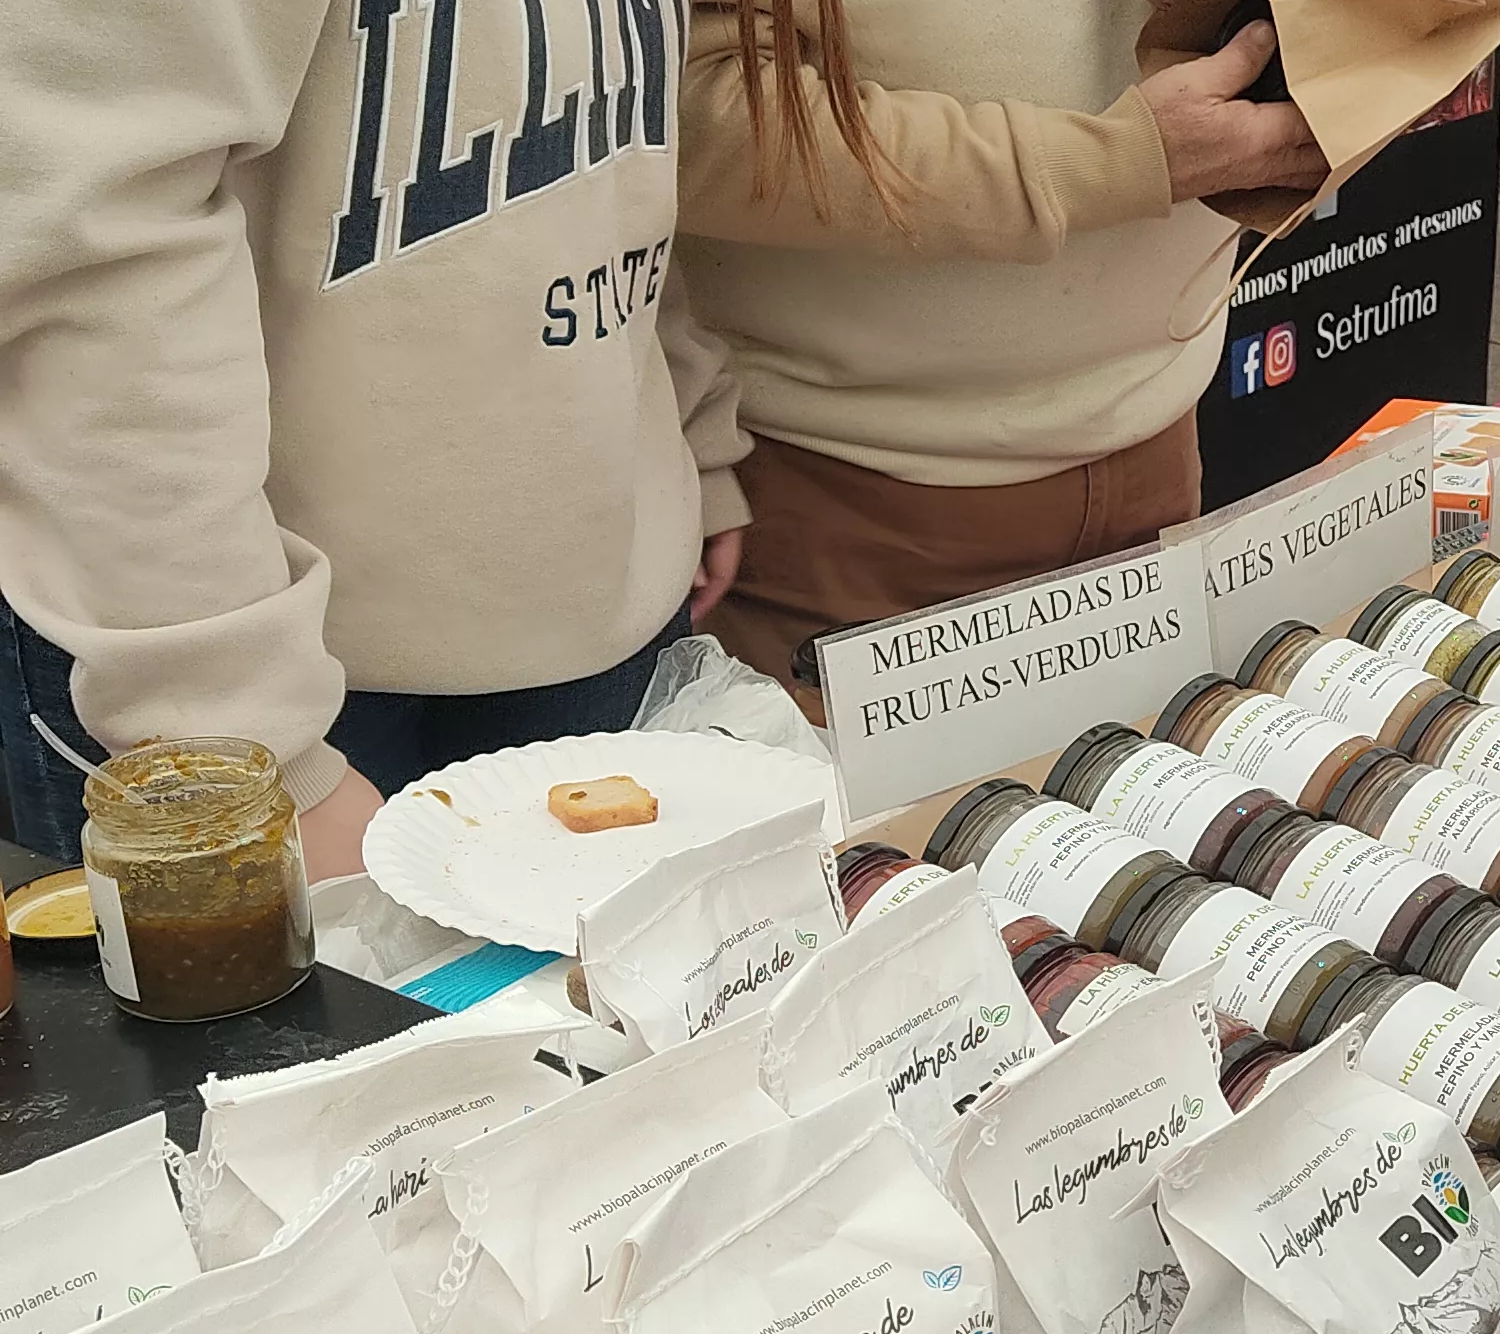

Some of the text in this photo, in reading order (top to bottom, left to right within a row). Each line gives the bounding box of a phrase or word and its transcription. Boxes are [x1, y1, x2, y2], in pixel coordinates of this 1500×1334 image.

[1230, 198, 1483, 308] amos productos artesanos
[1315, 281, 1439, 360] Setrufma
[1203, 468, 1429, 601] ATÉS VEGETALES
[869, 560, 1163, 677] MERMELADAS DE
[859, 607, 1182, 738] FRUTAS-VERDURAS
[1232, 704, 1270, 738] HUERTA
[1461, 720, 1497, 765] HUERTA
[1119, 755, 1158, 796] HUERTA
[1018, 810, 1066, 848] HUERTA
[1415, 789, 1449, 836] HUERTA
[1438, 788, 1491, 838] MERMELADA
[1049, 831, 1092, 870] PEPINO
[1310, 840, 1349, 880] HUERTA
[770, 942, 795, 975] de
[1246, 935, 1286, 982] PEPINO
[960, 1016, 990, 1053] de
[1399, 1021, 1448, 1087] HUERTA
[1433, 1011, 1498, 1079] MERMELADA
[1437, 1050, 1476, 1107] PEPINO
[1024, 1075, 1168, 1156] www.biopalacinplanet.com
[1014, 1104, 1187, 1225] Las legumbres de
[1375, 1139, 1403, 1176] de
